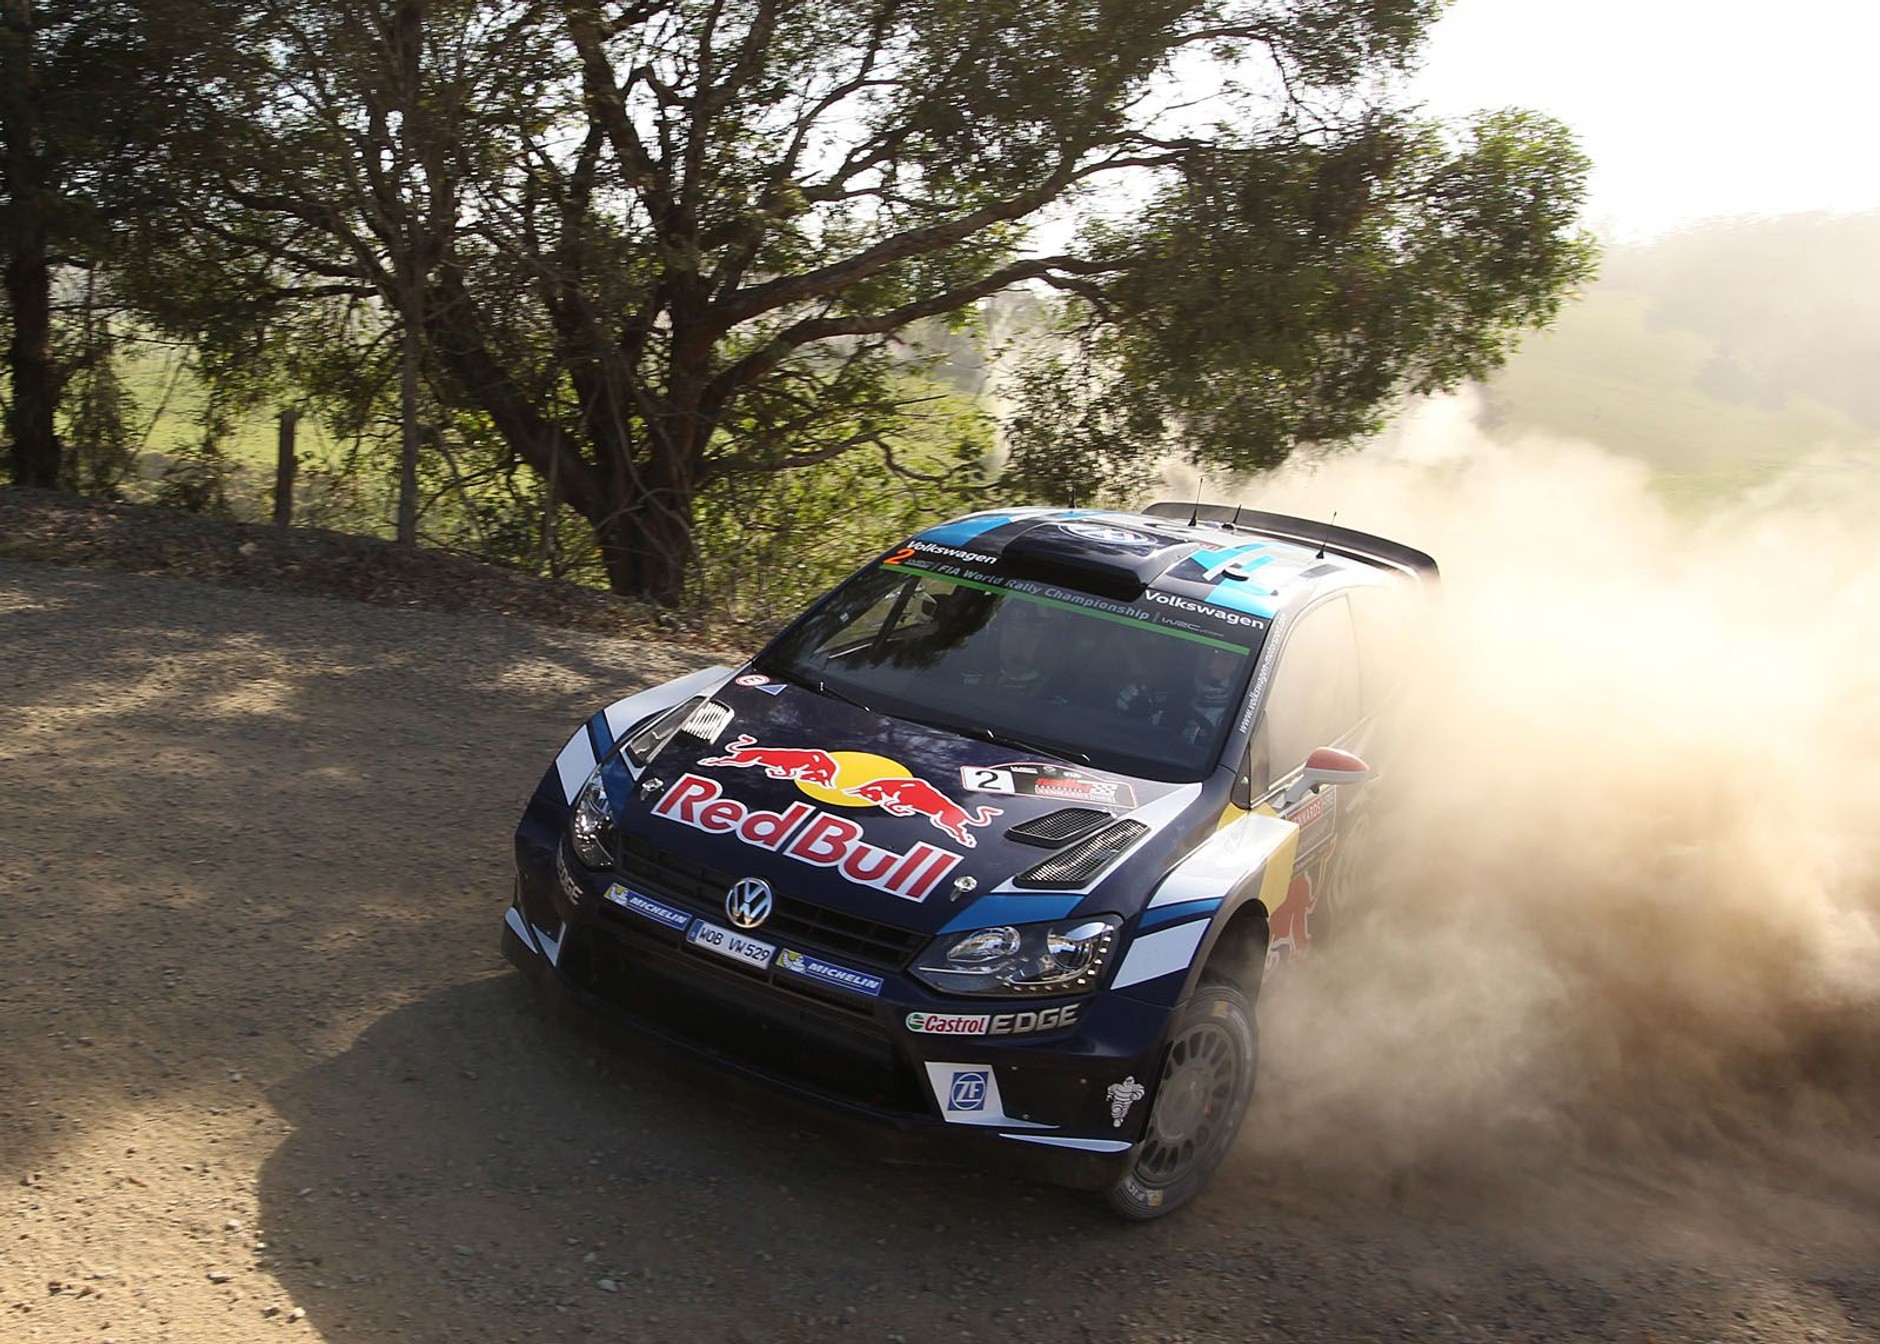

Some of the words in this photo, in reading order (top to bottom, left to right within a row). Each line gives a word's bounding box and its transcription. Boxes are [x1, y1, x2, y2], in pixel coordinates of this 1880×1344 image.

[883, 549, 915, 564] 2
[906, 540, 998, 565] Volkswagen
[938, 564, 960, 576] FIA
[963, 570, 1003, 585] World
[1005, 579, 1042, 594] Rally
[1045, 588, 1150, 621] Championship
[1144, 589, 1265, 630] Volkswagen
[975, 771, 1002, 790] 2
[652, 773, 809, 851] Red
[785, 813, 963, 902] Bull
[629, 896, 688, 925] MICHELIN
[698, 926, 723, 946] WOB
[808, 962, 879, 989] MICHELIN
[924, 1015, 986, 1034] Castrol
[988, 1003, 1081, 1035] EDGE
[953, 1078, 985, 1104] ZF
